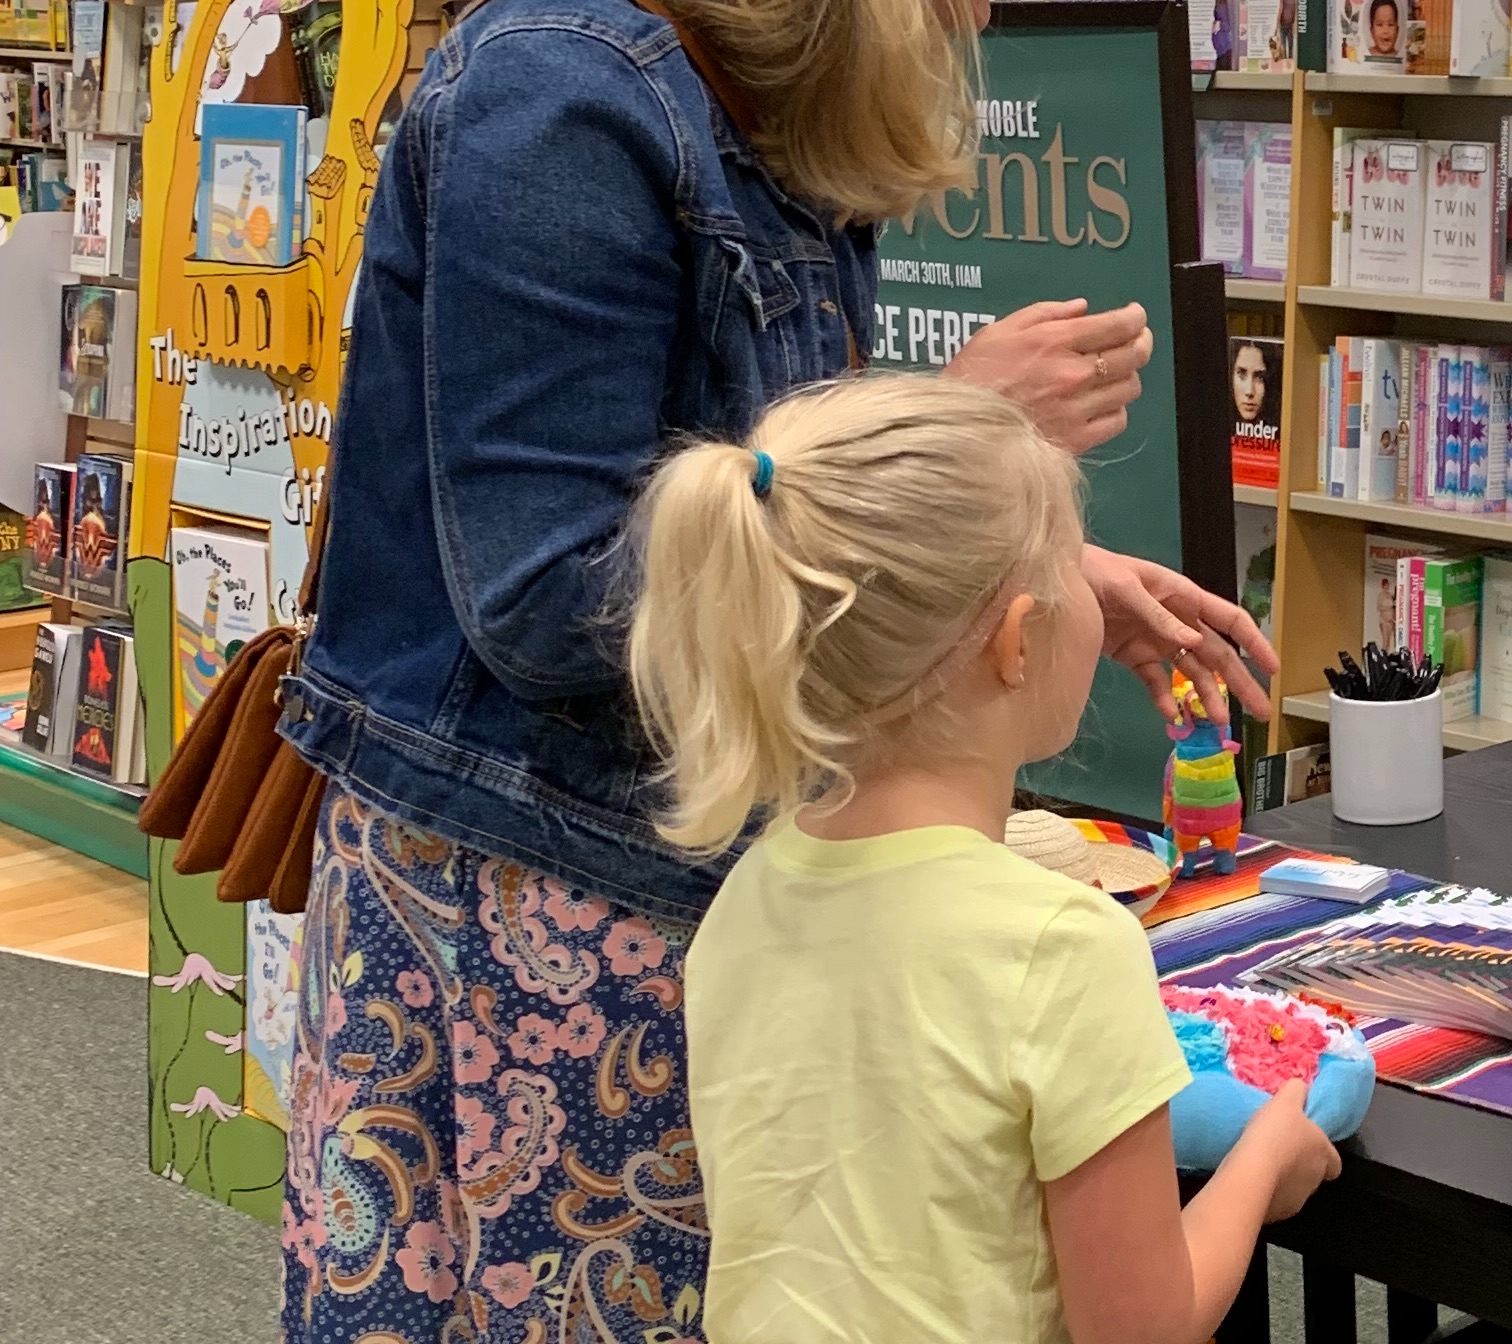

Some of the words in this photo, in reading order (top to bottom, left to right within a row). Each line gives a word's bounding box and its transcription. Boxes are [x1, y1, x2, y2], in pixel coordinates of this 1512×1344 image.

[975, 100, 1040, 138] NOBLE
[1500, 120, 1508, 174] PREGNANCY
[1361, 196, 1404, 212] TWIN
[1434, 200, 1476, 216] TWIN
[1499, 176, 1507, 211] FITNESS
[1360, 225, 1404, 243] TWIN
[1433, 230, 1476, 247] TWIN
[880, 259, 920, 283] MARCH
[921, 262, 955, 288] 30TH,
[150, 327, 198, 384] The
[179, 386, 332, 475] Inspiration
[1236, 421, 1279, 440] under
[280, 466, 326, 526] Gif
[204, 544, 232, 573] Places
[234, 593, 254, 611] Go!
[1410, 573, 1421, 633] pregnant!
